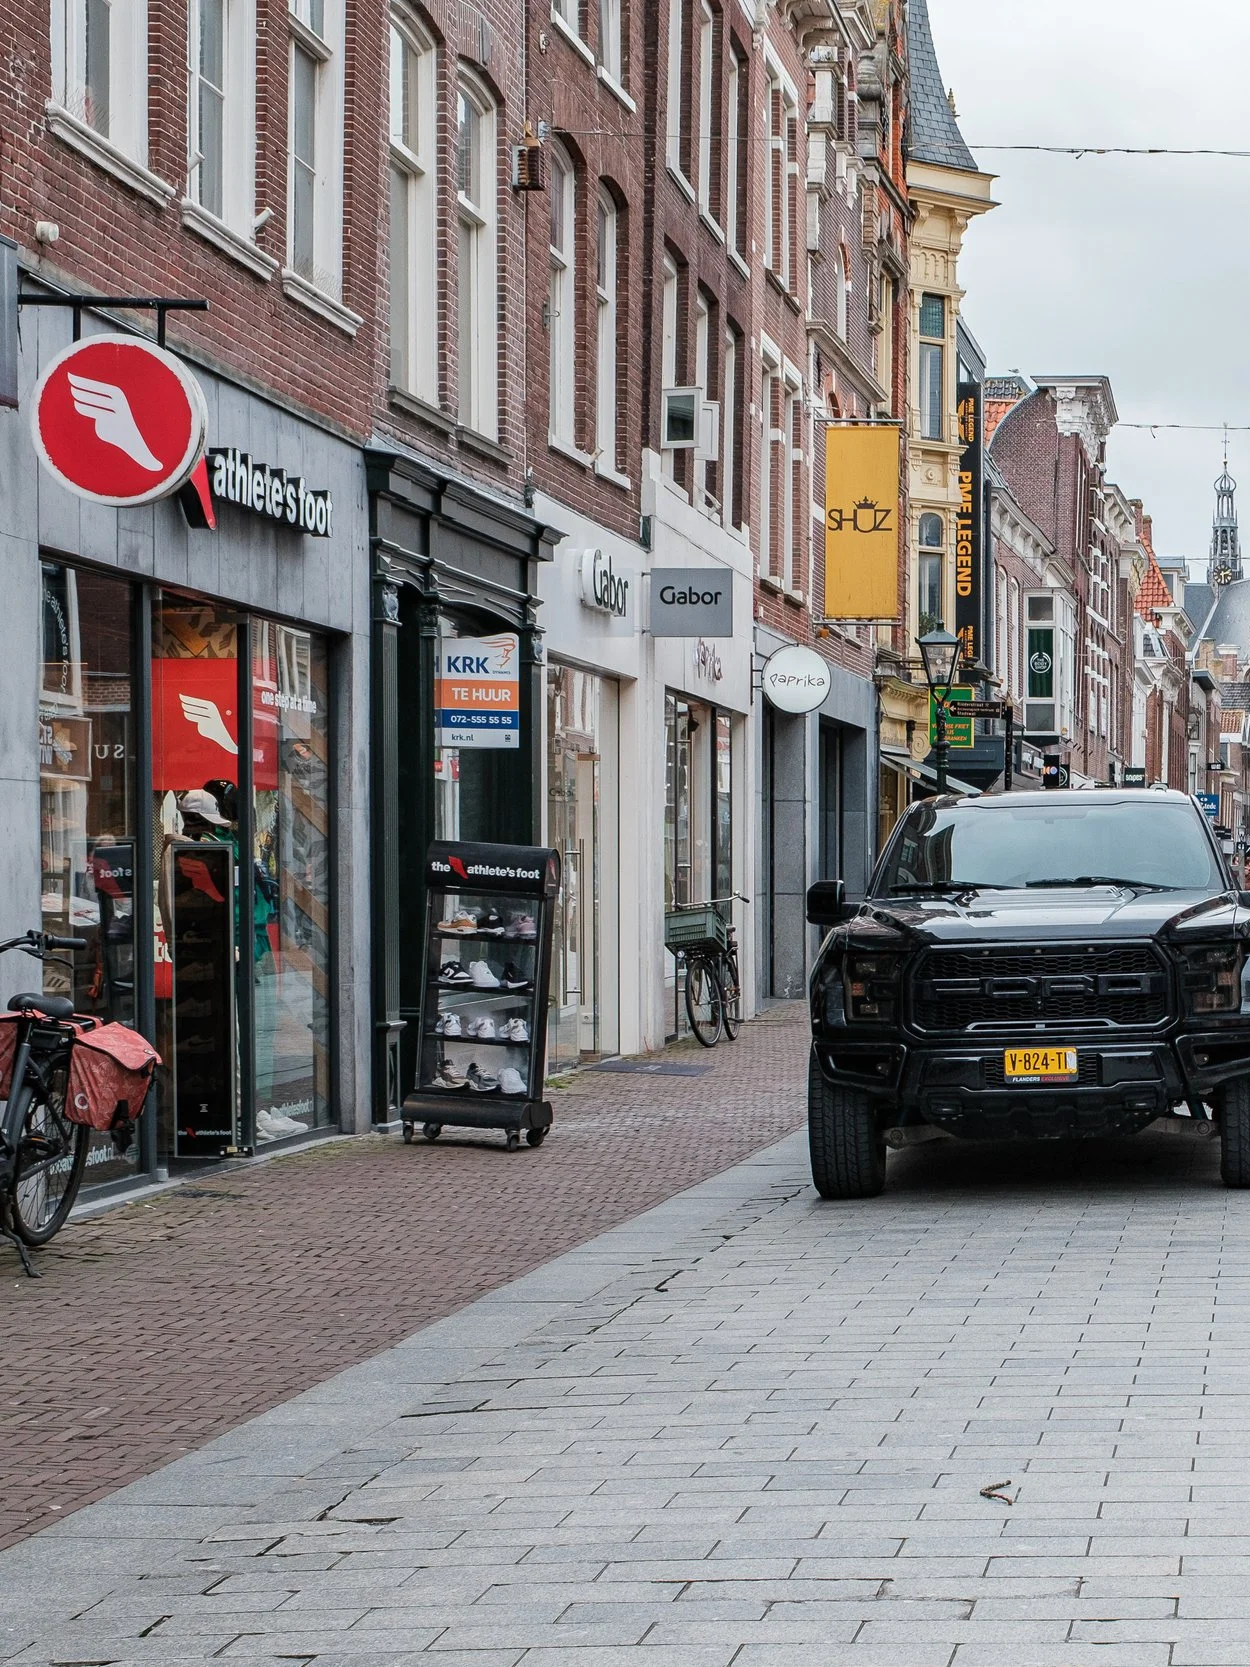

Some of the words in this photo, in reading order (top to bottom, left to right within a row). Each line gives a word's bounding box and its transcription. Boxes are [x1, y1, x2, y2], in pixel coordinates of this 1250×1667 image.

[213, 447, 297, 524] athlete's
[298, 477, 333, 538] foot
[959, 471, 972, 513] PME
[957, 520, 972, 597] LEGEND
[593, 549, 628, 617] Gabor
[660, 586, 722, 605] Gabor
[447, 656, 490, 674] KRK
[769, 673, 825, 688] paprika
[451, 687, 469, 700] TE
[472, 688, 511, 701] HUUR
[450, 715, 487, 724] 072-555
[488, 715, 500, 724] 55
[501, 716, 512, 724] 55
[451, 733, 474, 742] krk.nl
[431, 861, 451, 872] the
[467, 864, 515, 878] athlete's
[516, 866, 540, 879] foot
